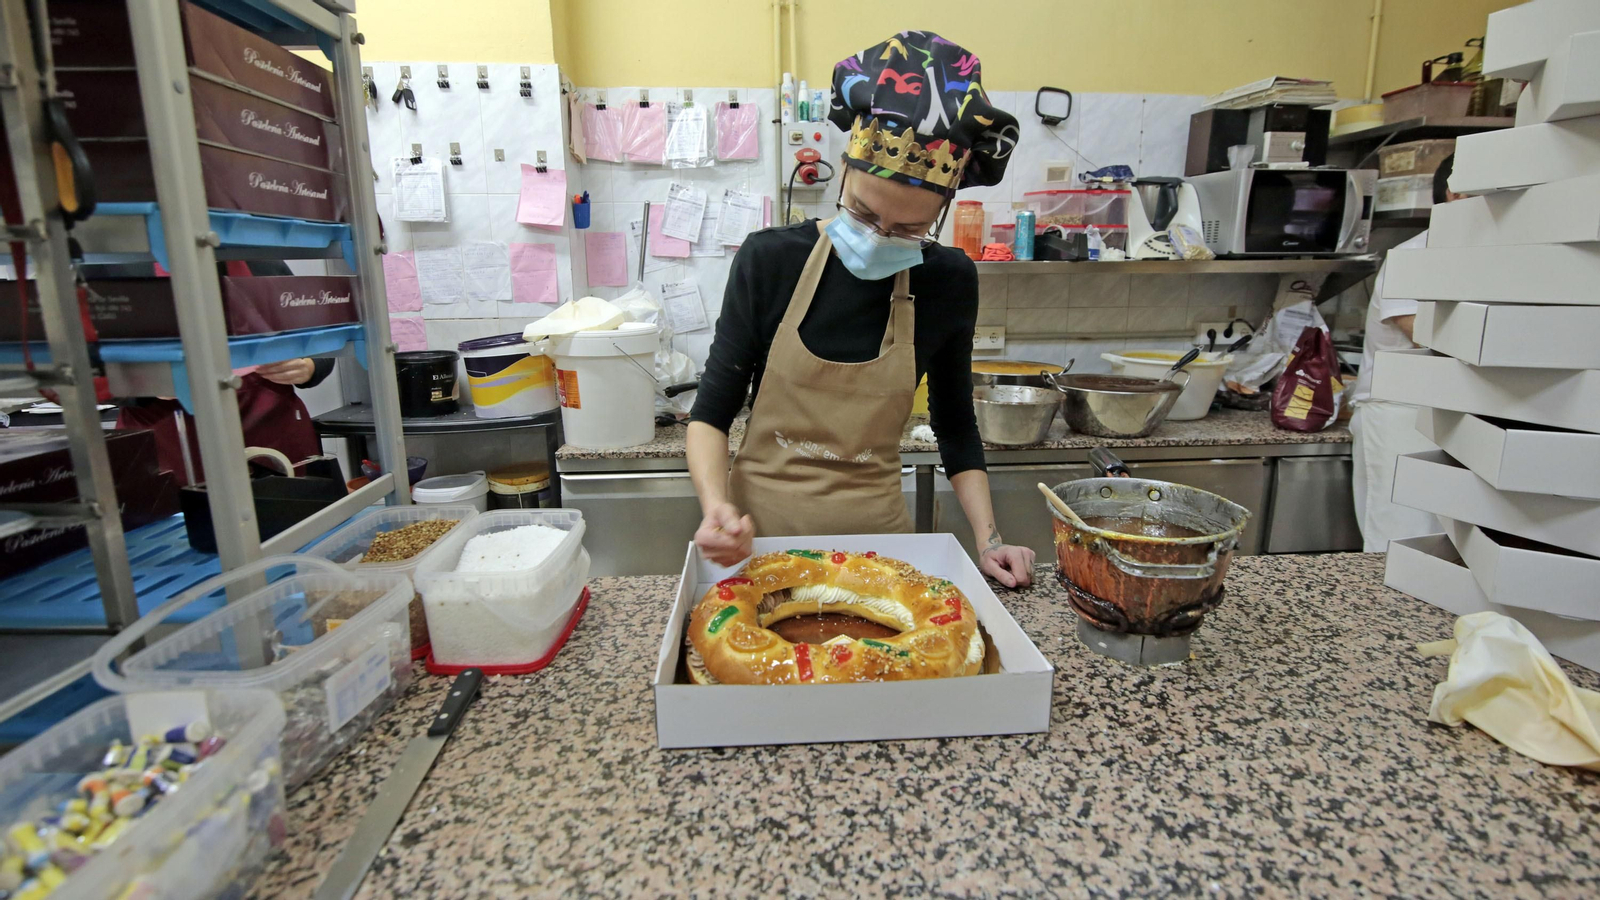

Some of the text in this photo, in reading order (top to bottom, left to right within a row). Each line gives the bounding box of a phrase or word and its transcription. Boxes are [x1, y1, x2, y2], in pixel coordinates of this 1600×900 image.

[285, 65, 322, 93] Artesanal
[283, 122, 321, 147] Artesanal
[289, 179, 328, 200] Artesanal
[316, 289, 351, 306] Artesanal
